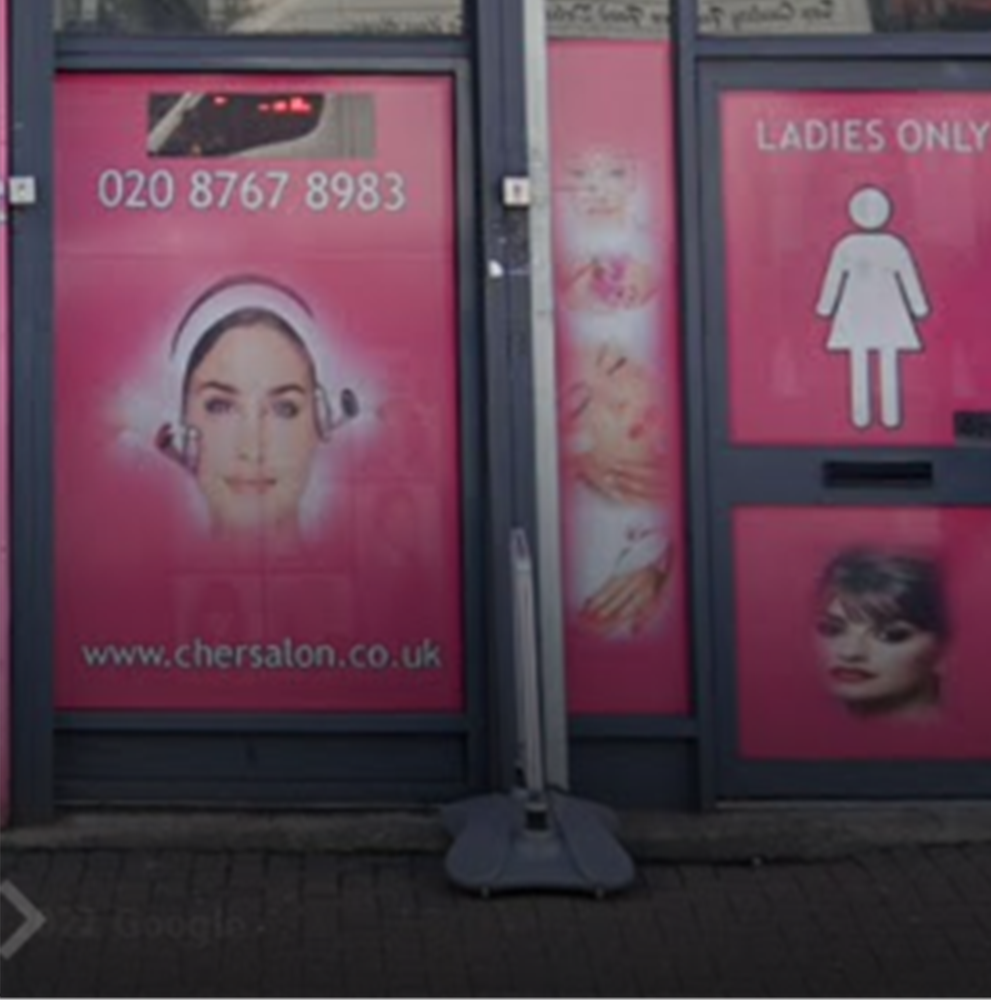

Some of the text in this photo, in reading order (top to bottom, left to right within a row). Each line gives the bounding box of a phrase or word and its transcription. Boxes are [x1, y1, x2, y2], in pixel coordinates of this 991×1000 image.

[756, 119, 991, 154] LADIES ONLY
[99, 168, 407, 212] 020 8767 8983
[81, 637, 443, 670] www.chersalon.co.uk
